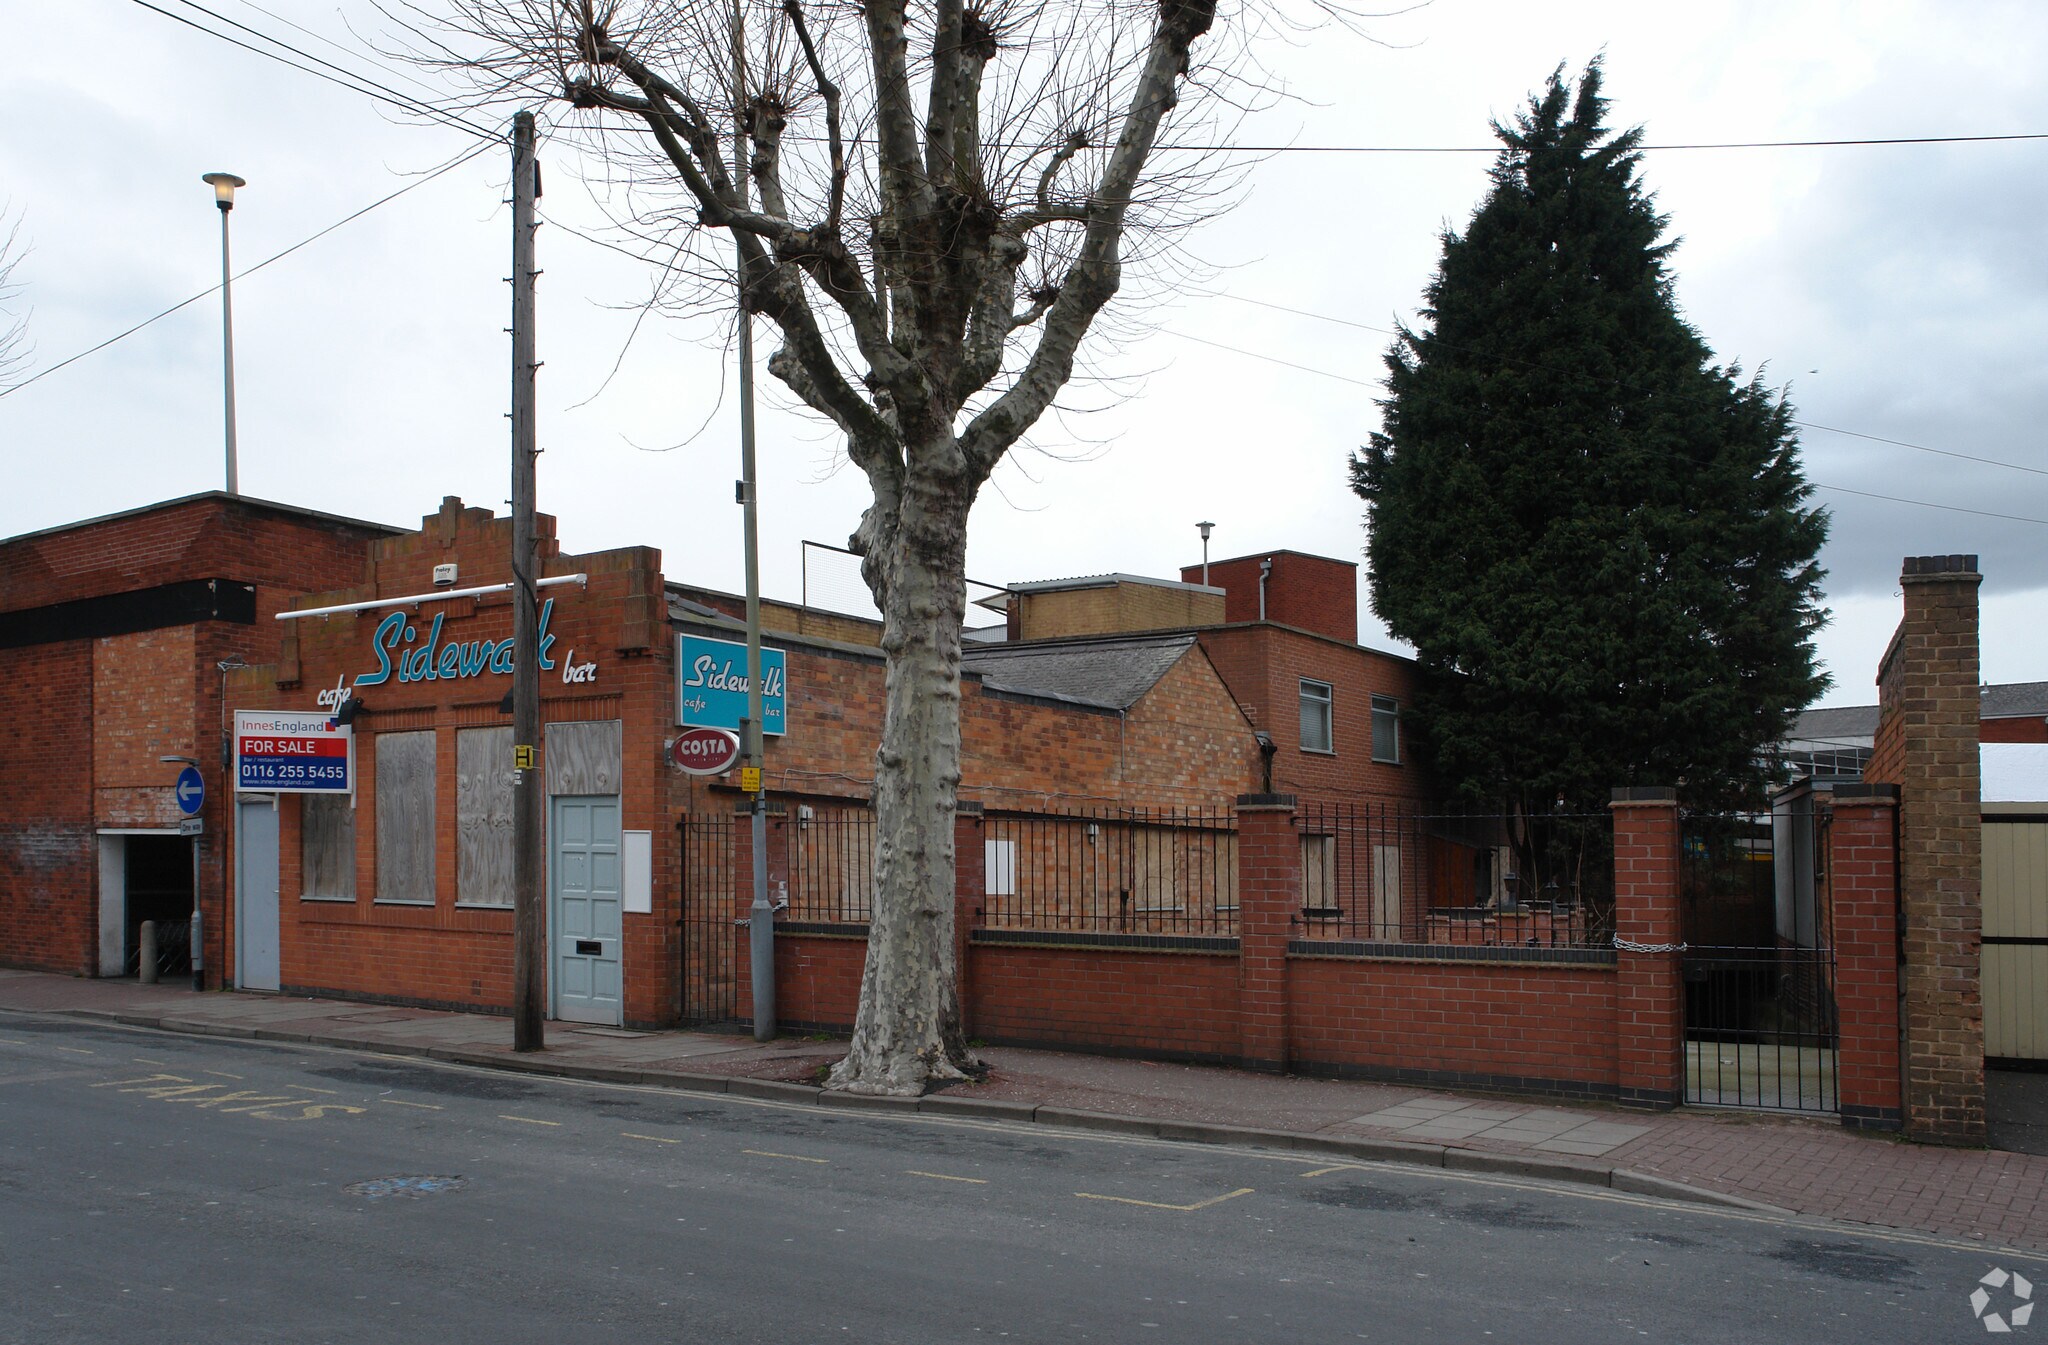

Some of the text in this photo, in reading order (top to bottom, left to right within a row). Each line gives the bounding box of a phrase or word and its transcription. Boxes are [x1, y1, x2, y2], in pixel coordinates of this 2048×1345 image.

[354, 598, 556, 687] Sidewak
[562, 649, 597, 684] bar
[685, 655, 782, 697] Sidewlk
[317, 673, 352, 714] cafe
[684, 695, 780, 717] cafe bar
[242, 720, 324, 734] InnesEngland
[245, 740, 316, 754] FOR SALE
[515, 747, 530, 766] H
[681, 739, 727, 756] COSTA
[242, 764, 344, 779] 0116 255 5455
[243, 779, 315, 787] www.innes-england.com
